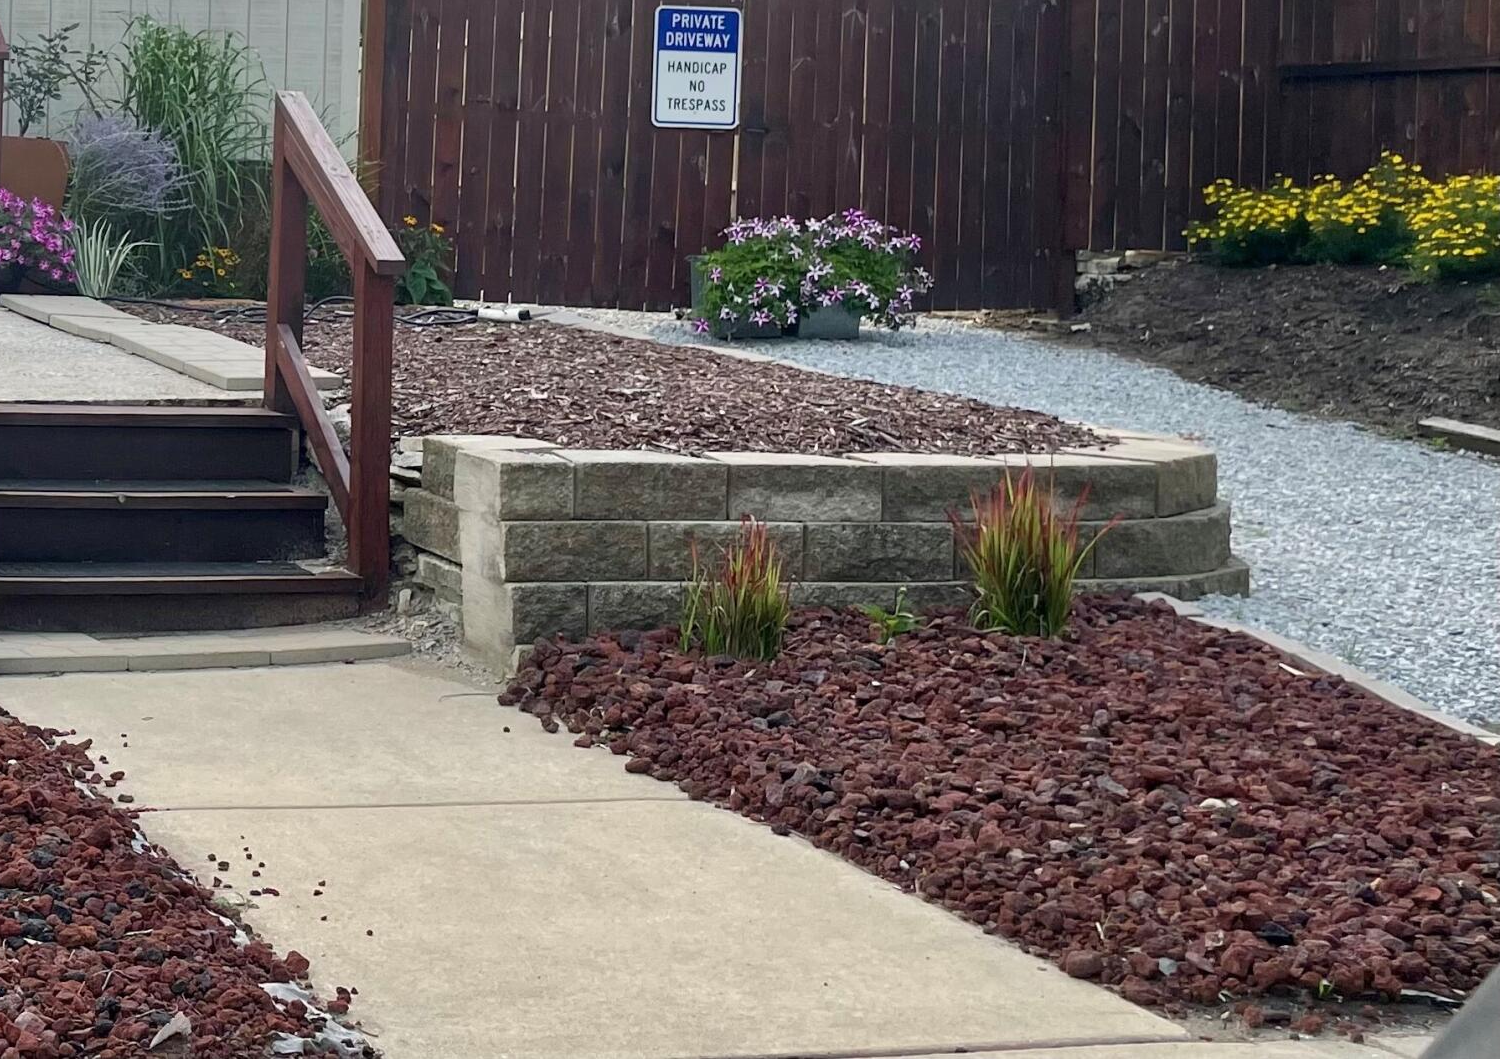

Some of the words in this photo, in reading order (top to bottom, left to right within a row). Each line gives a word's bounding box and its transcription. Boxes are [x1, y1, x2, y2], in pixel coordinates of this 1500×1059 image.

[672, 13, 725, 29] PRIVATE
[665, 31, 730, 49] DRIVEWAY
[667, 61, 727, 75] HANDICAP
[689, 80, 705, 92] NO
[667, 97, 726, 112] TRESPASS
